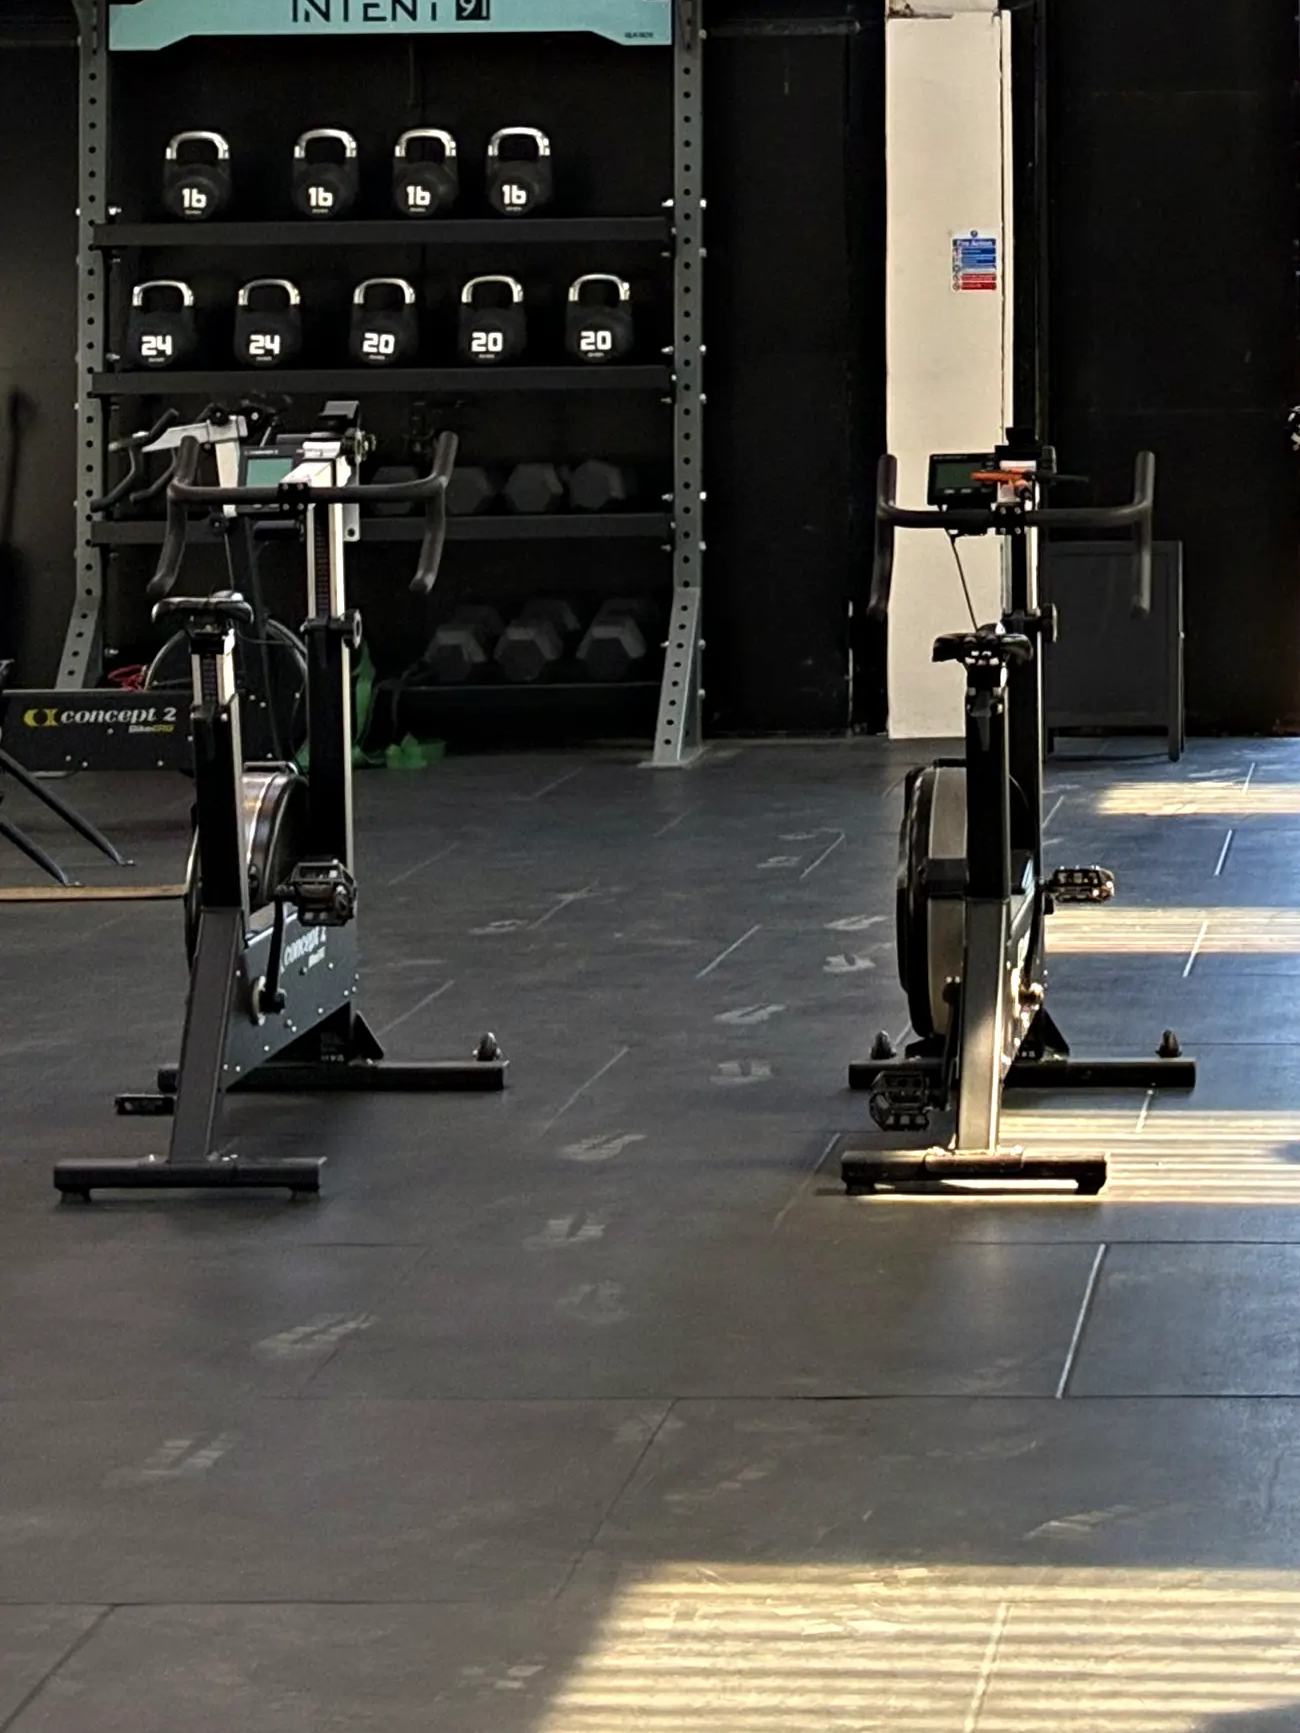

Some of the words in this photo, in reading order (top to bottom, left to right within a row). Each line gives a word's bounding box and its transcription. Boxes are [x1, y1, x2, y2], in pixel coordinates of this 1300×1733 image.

[182, 188, 207, 208] 16
[308, 186, 333, 207] 16
[406, 185, 431, 206] 16
[502, 184, 527, 205] 16
[141, 335, 173, 356] 24
[249, 334, 281, 354] 24
[363, 332, 395, 354] 20
[471, 331, 503, 352] 20
[580, 330, 612, 351] 20
[60, 707, 157, 724] concept
[163, 707, 177, 721] 2
